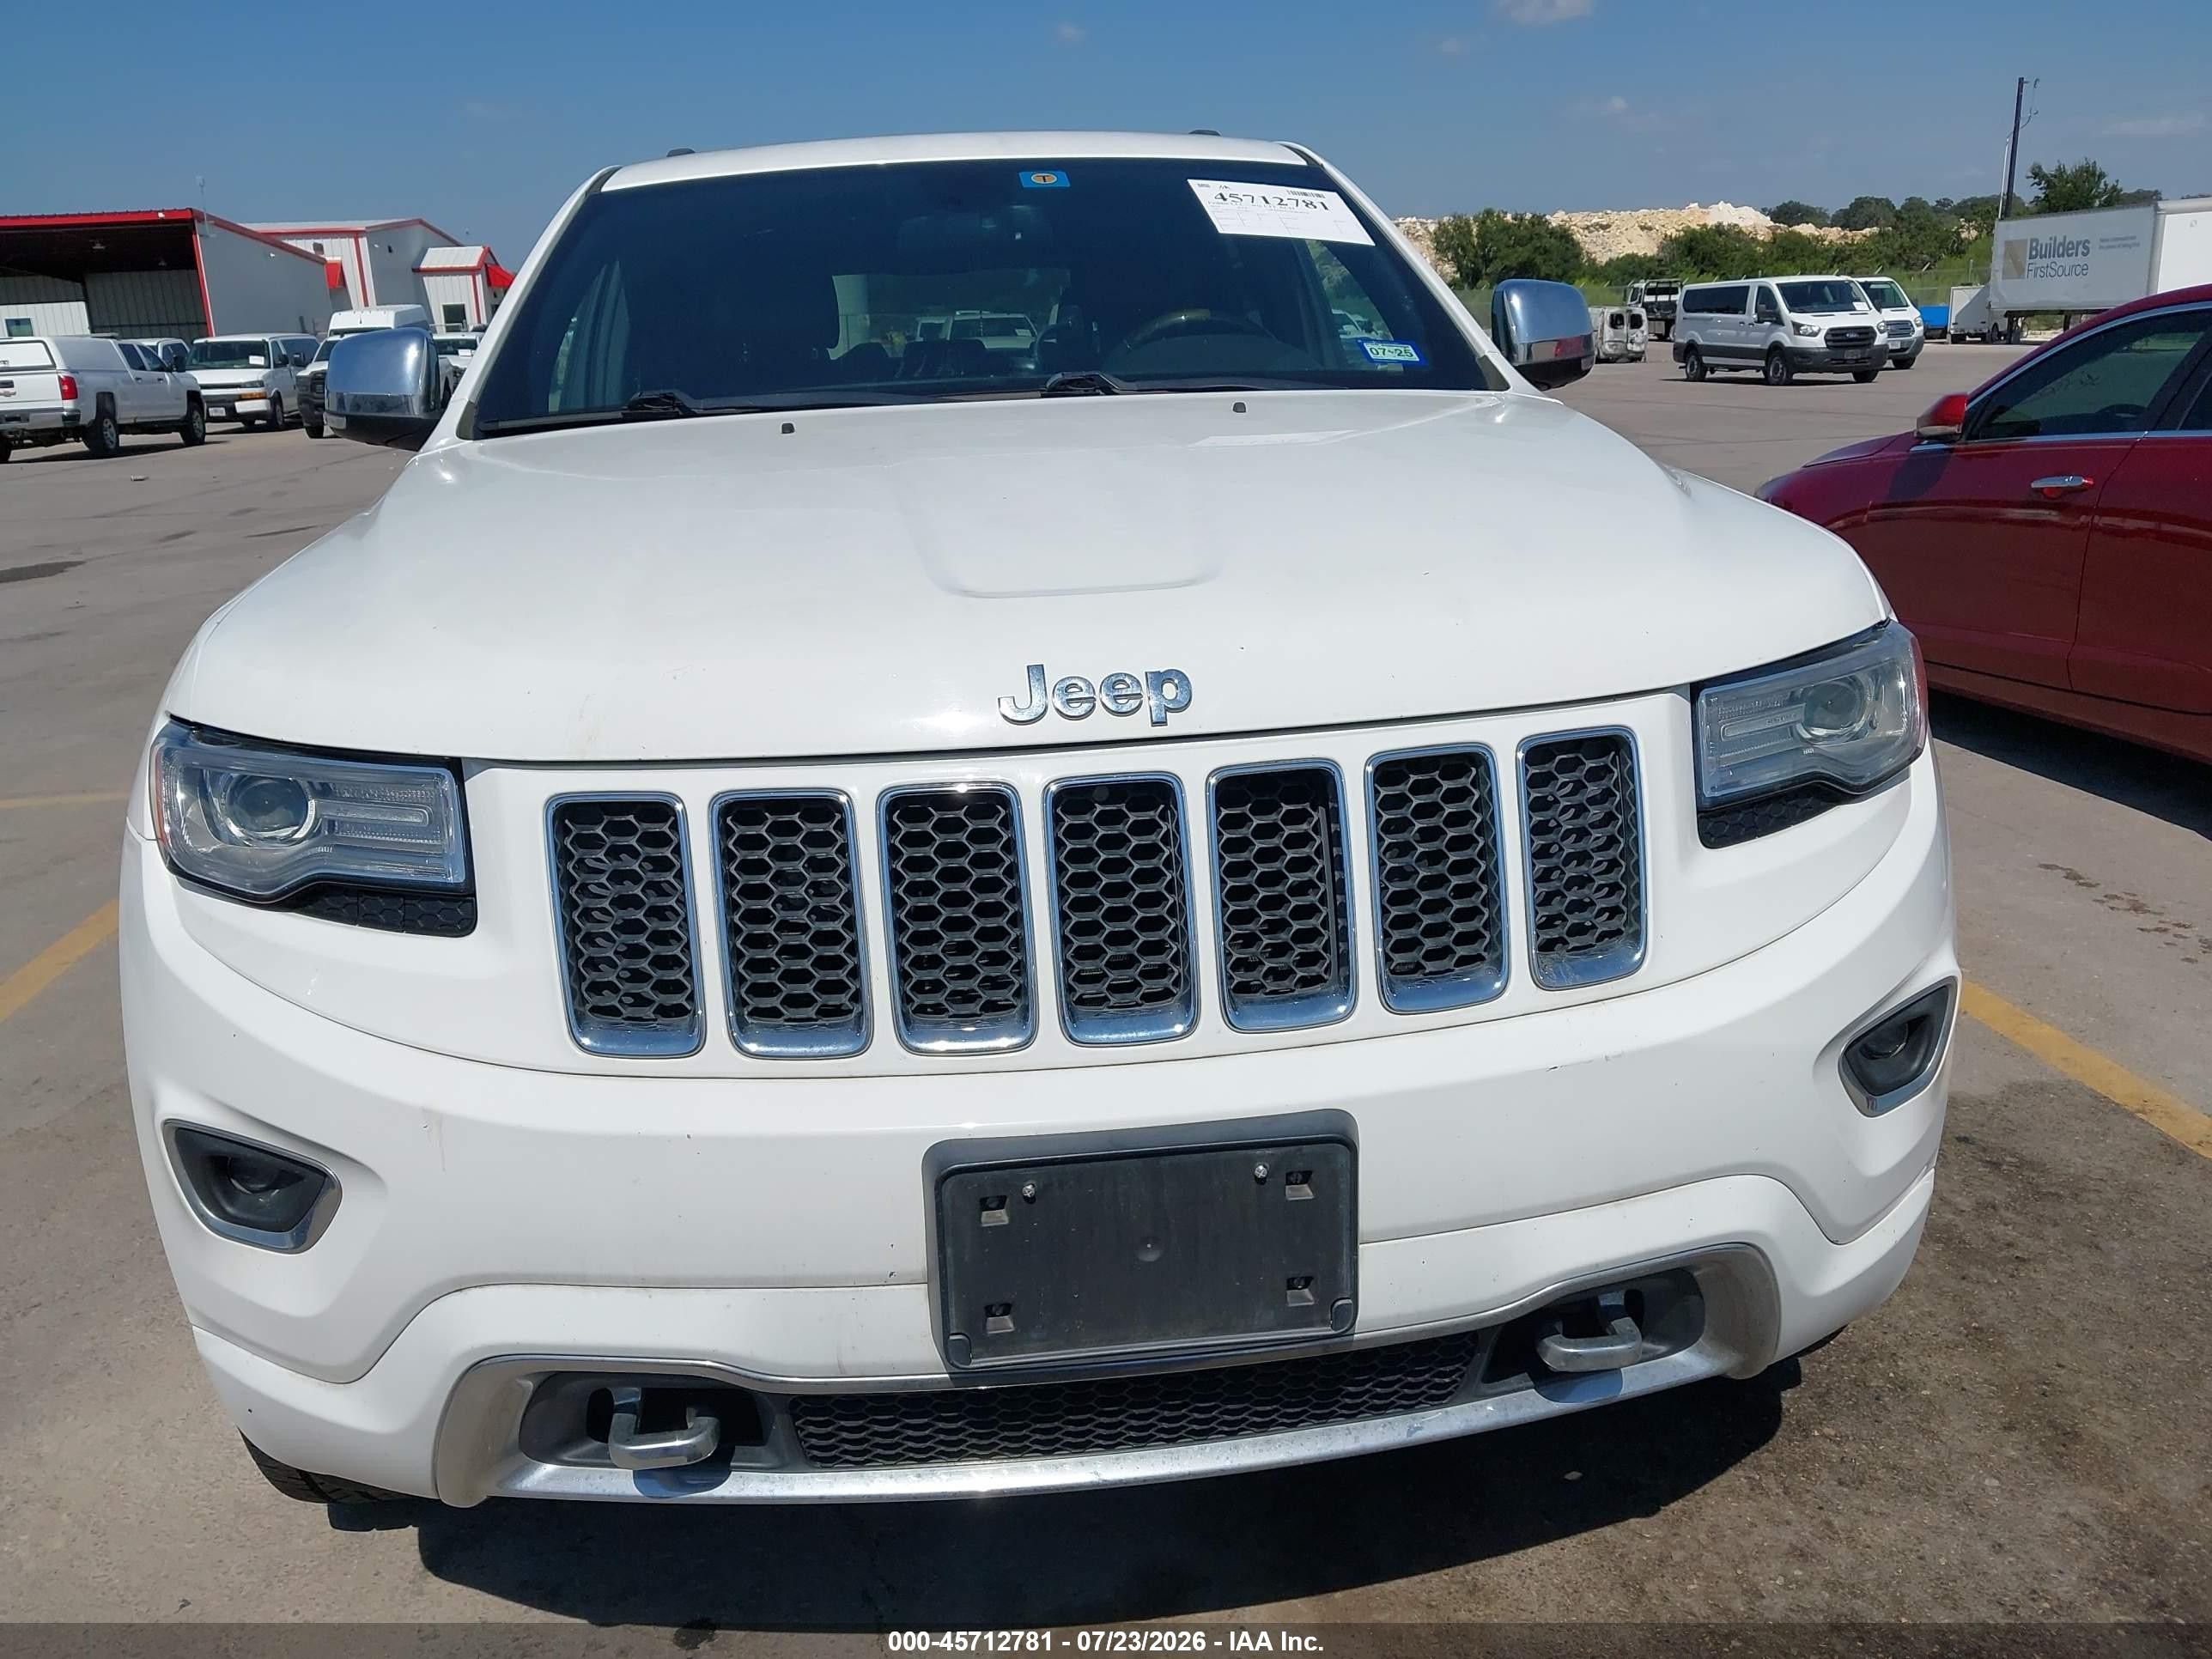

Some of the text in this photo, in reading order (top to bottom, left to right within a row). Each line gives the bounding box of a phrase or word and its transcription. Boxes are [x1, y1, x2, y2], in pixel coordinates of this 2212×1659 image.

[1214, 191, 1330, 210] 45712781
[2028, 235, 2090, 259] Builders
[2027, 260, 2088, 278] FirstSource
[998, 664, 1192, 726] Jeep
